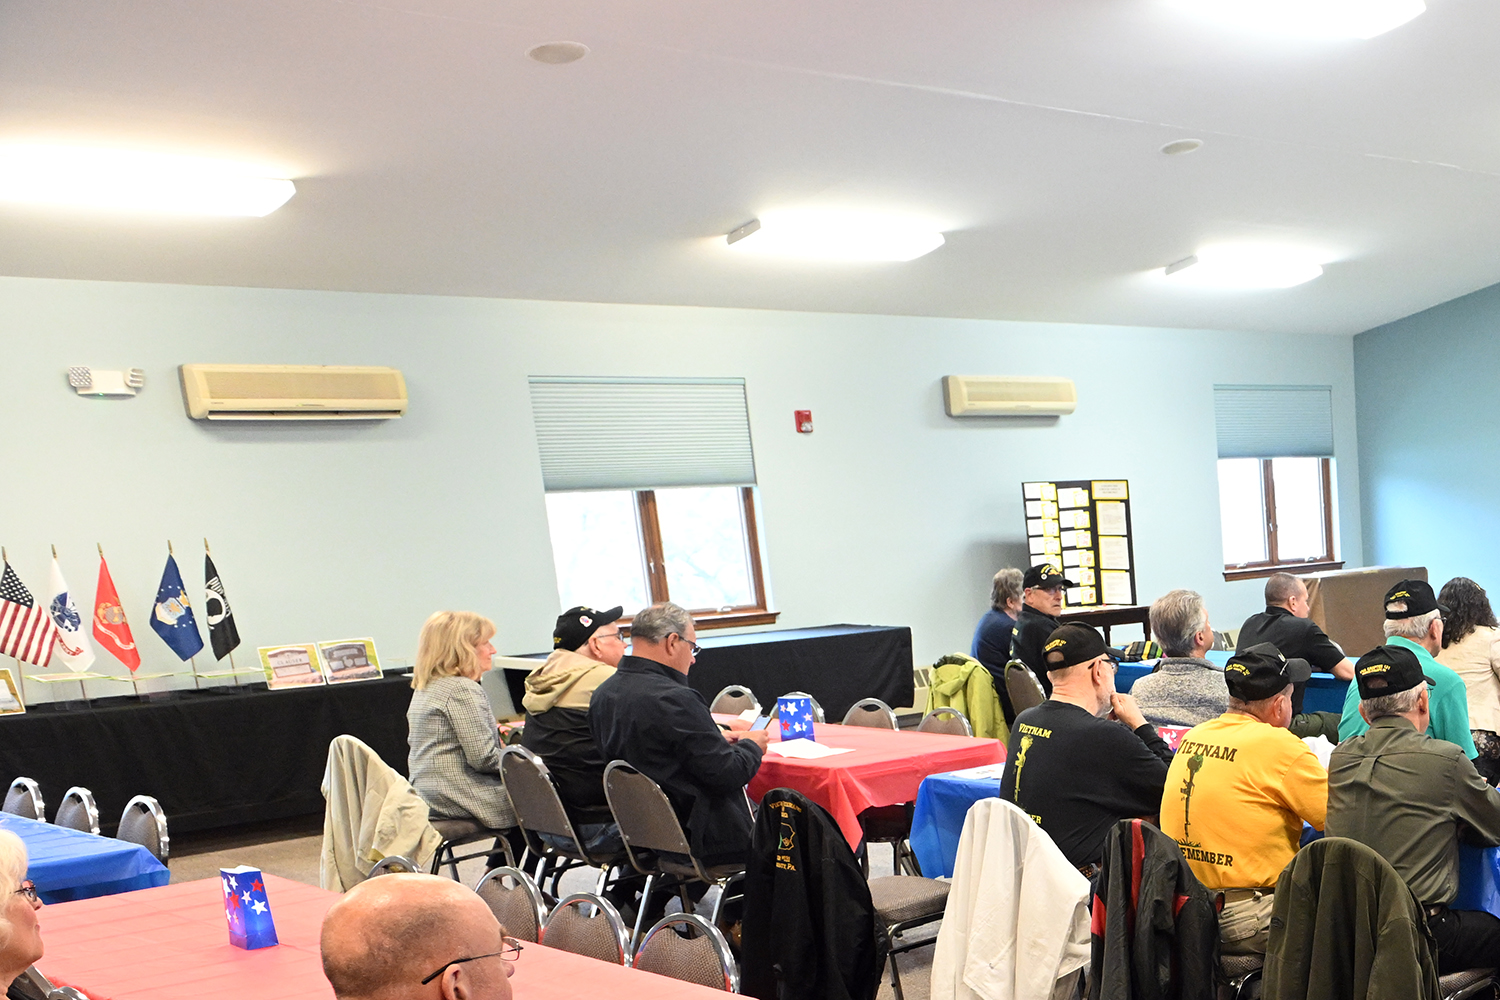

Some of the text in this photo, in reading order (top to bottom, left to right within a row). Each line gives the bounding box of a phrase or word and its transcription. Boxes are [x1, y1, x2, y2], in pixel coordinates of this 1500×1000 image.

[1018, 722, 1053, 740] VIETNAM
[1176, 738, 1238, 763] VIETNAM
[1179, 847, 1234, 867] EMEMBER
